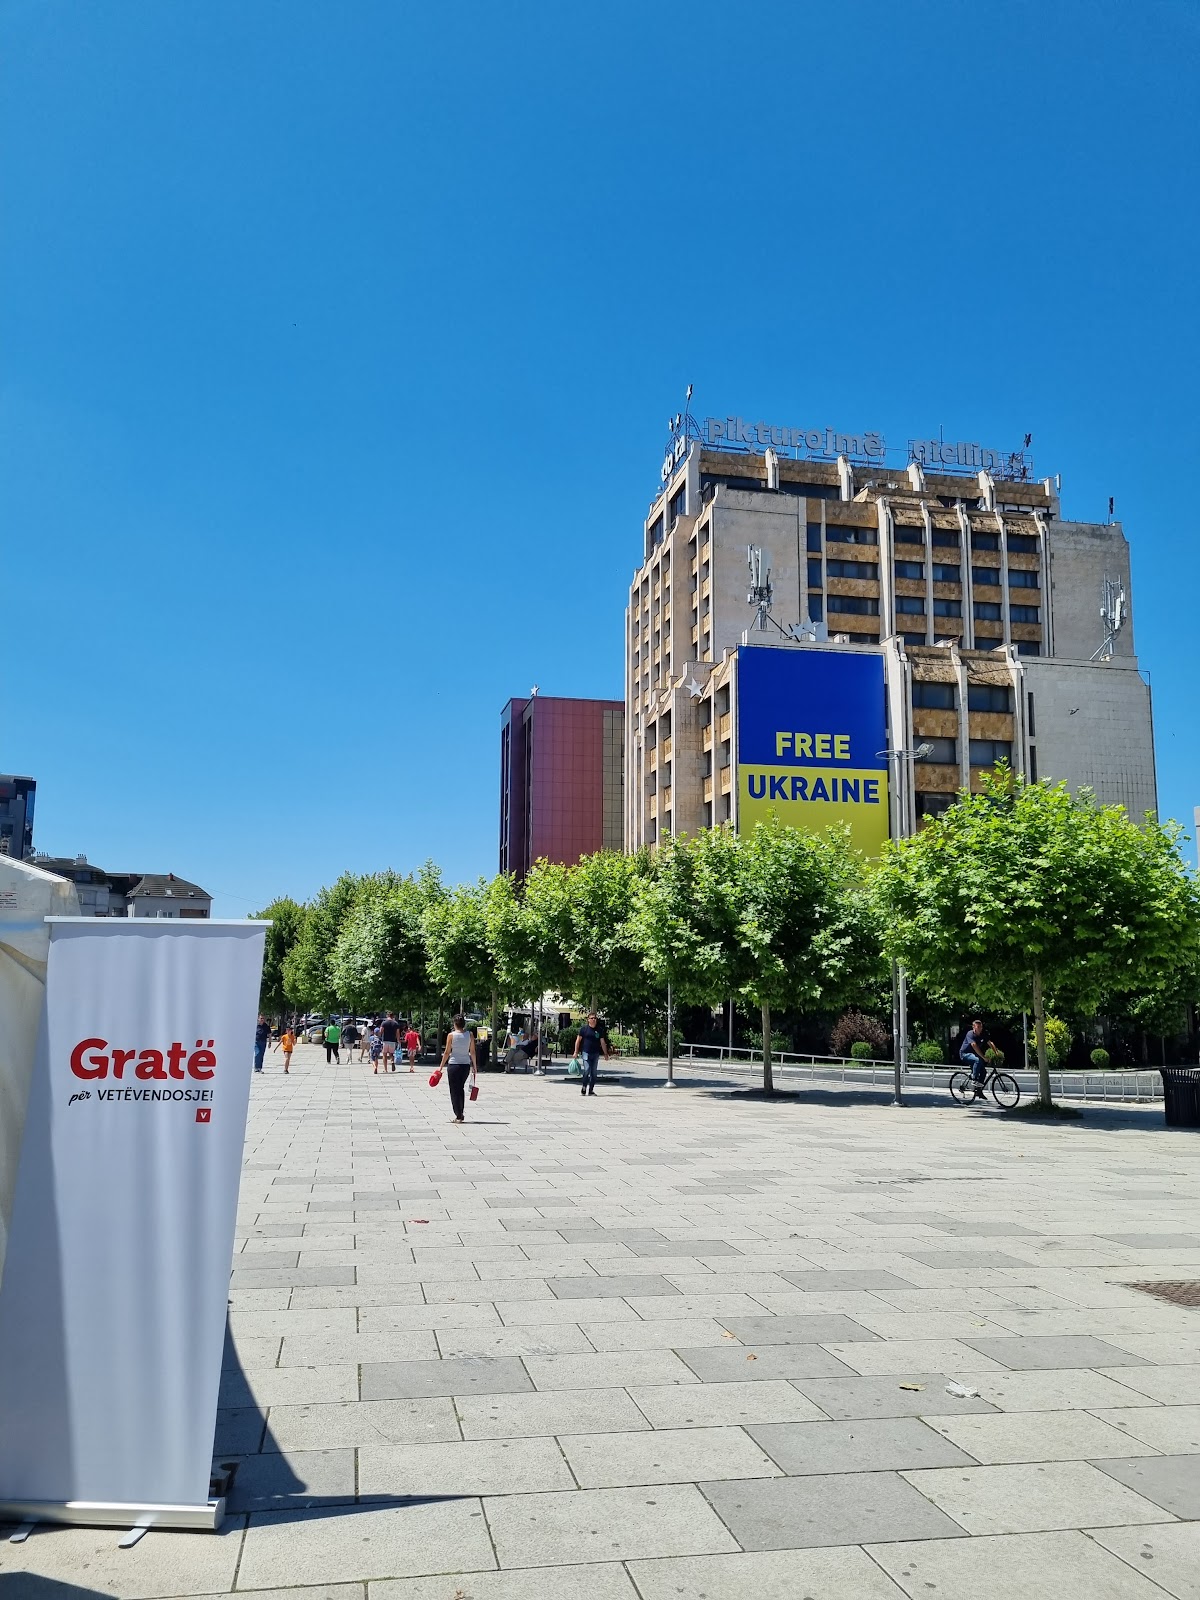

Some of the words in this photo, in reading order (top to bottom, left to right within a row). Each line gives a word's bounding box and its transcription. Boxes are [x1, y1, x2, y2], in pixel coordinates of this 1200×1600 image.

[708, 416, 881, 457] pikturojmë
[776, 732, 850, 759] FREE
[748, 775, 879, 804] UKRAINE
[70, 1038, 216, 1080] Gratë
[68, 1090, 92, 1106] për
[97, 1087, 214, 1102] VETËVENDOSJE!
